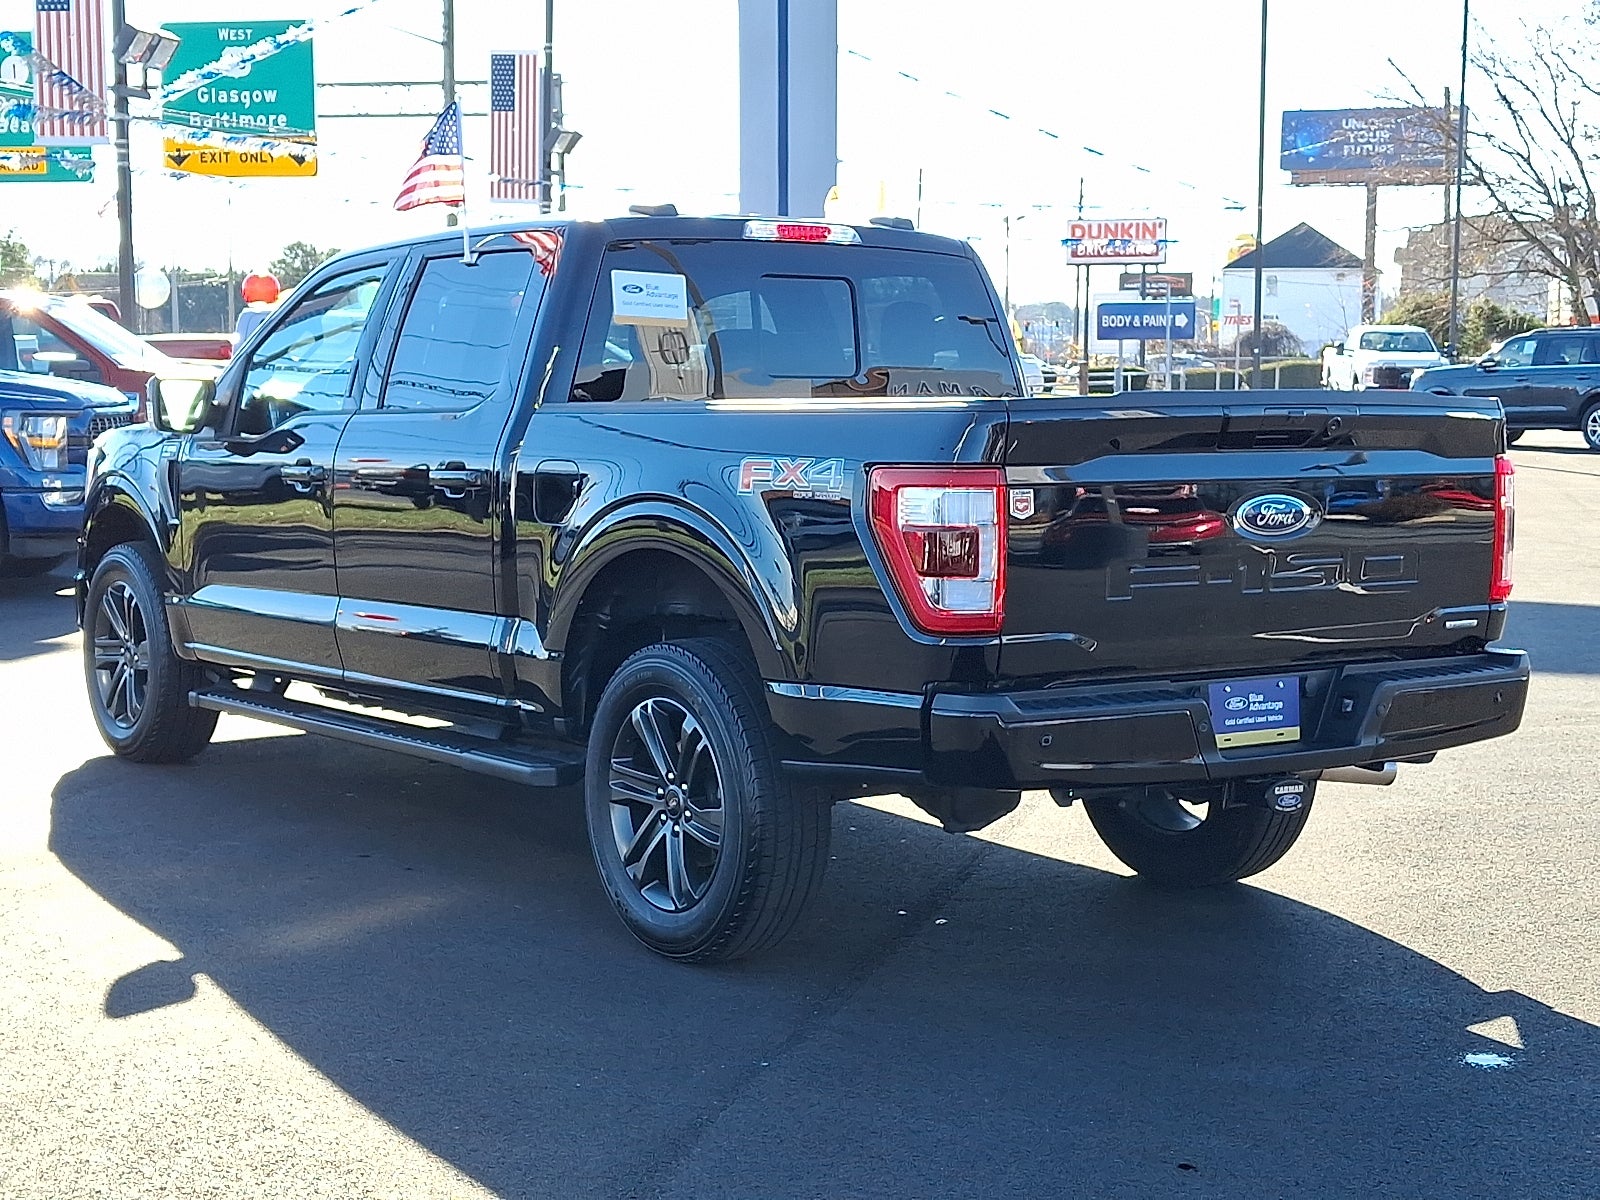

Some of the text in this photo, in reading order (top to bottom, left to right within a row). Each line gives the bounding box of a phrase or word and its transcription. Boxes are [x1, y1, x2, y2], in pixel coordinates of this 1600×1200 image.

[217, 28, 253, 41] WEST
[197, 87, 278, 109] Glasgow
[189, 112, 288, 128] Baltimore
[1348, 130, 1392, 143] YOUR
[200, 151, 276, 163] EXIT ONLY
[1070, 221, 1163, 239] DUNKIN'
[1101, 315, 1131, 327] BODY
[1133, 315, 1141, 327] &
[737, 456, 845, 496] FX4
[1255, 502, 1297, 527] Ford
[1105, 550, 1420, 600] F-150
[1248, 693, 1264, 702] Blue
[1249, 701, 1283, 711] Advantage
